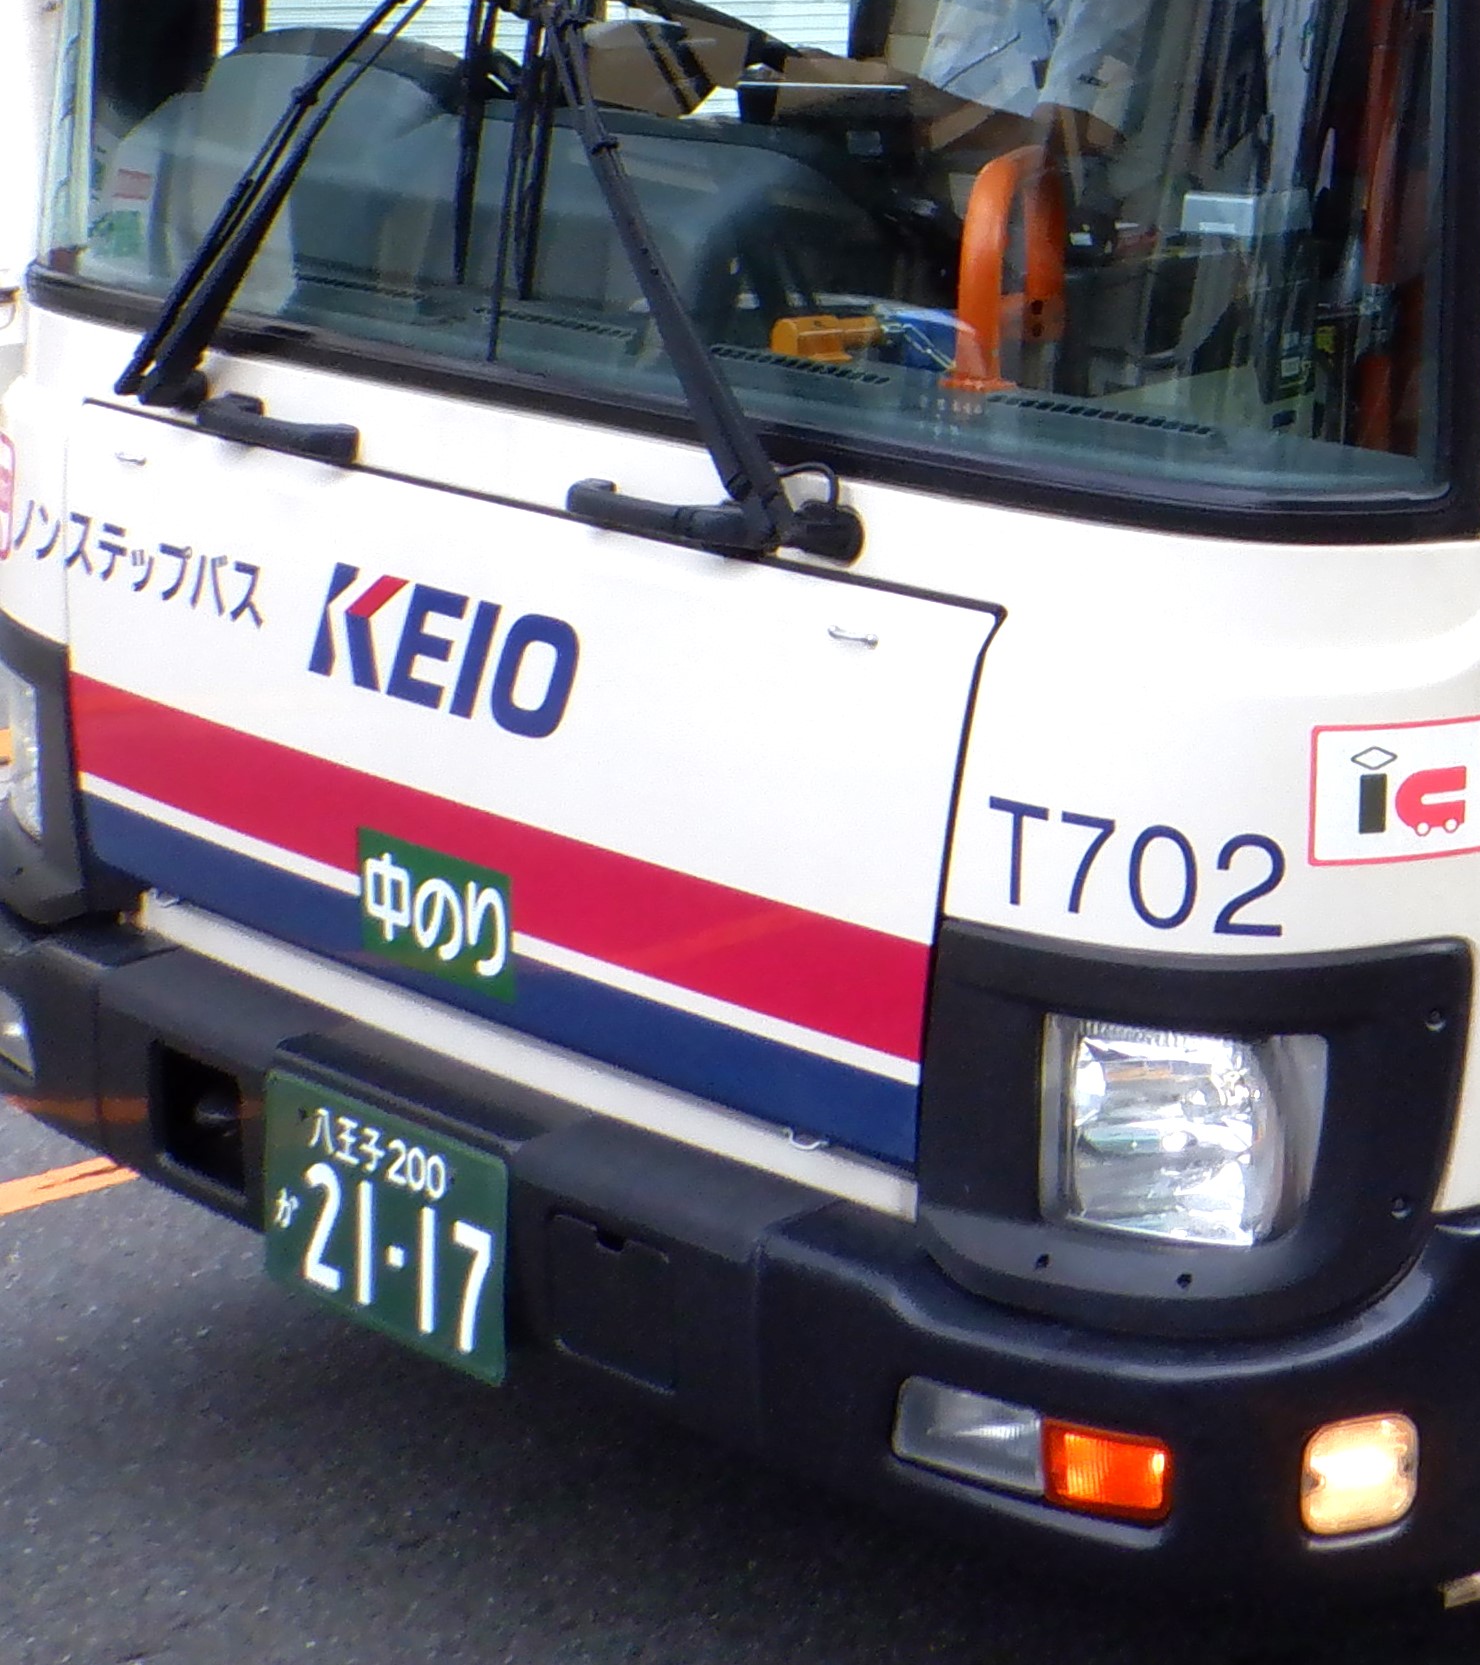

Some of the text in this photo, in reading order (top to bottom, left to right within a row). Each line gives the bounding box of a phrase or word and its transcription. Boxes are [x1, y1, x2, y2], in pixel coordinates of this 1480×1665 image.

[14, 500, 264, 629] ノンステップバス
[308, 562, 580, 739] KEIO
[362, 852, 509, 978] 中のり
[989, 795, 1286, 938] T702
